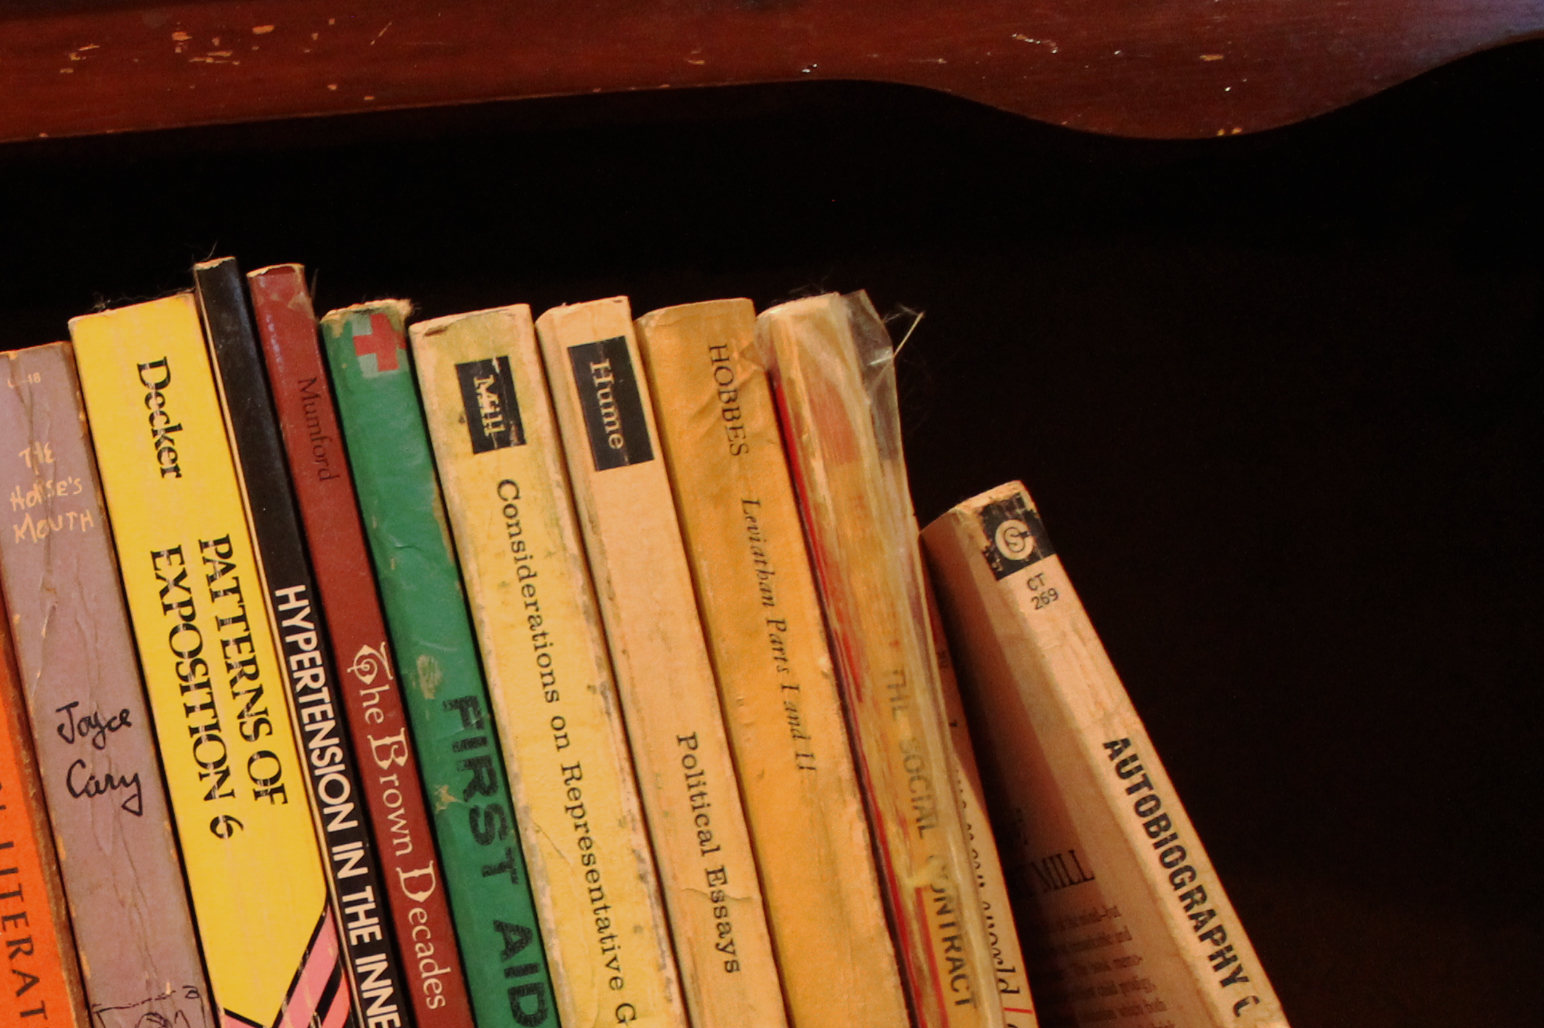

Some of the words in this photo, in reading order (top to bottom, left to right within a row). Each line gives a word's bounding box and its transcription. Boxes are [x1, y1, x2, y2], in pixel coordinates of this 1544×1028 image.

[134, 356, 182, 481] Decker
[295, 376, 339, 483] Mumford
[471, 372, 507, 437] Mill
[588, 357, 625, 451] Hume
[706, 341, 749, 457] HOBBES
[495, 477, 561, 704] Considerations
[739, 495, 776, 608] Leviathan
[765, 614, 788, 674] Parts
[781, 698, 810, 741] and
[1026, 573, 1046, 592] CT
[1030, 587, 1059, 611] 269
[55, 701, 132, 750] Joyce
[149, 544, 234, 803] EXPOSITION
[207, 811, 244, 842] 6
[197, 533, 274, 745] PATTERNS
[243, 747, 288, 810] OF
[274, 583, 358, 832] HYPERTENSION
[342, 641, 389, 725] The
[549, 713, 572, 752] on
[365, 726, 416, 858] Brown
[441, 693, 518, 891] FIRST
[675, 730, 721, 857] Political
[703, 863, 742, 975] Essays
[330, 841, 368, 879] IN
[340, 885, 382, 947] THE
[558, 762, 626, 992] Representative
[1101, 732, 1249, 994] AUTOBIOGRAPHY
[396, 859, 451, 1010] Decades
